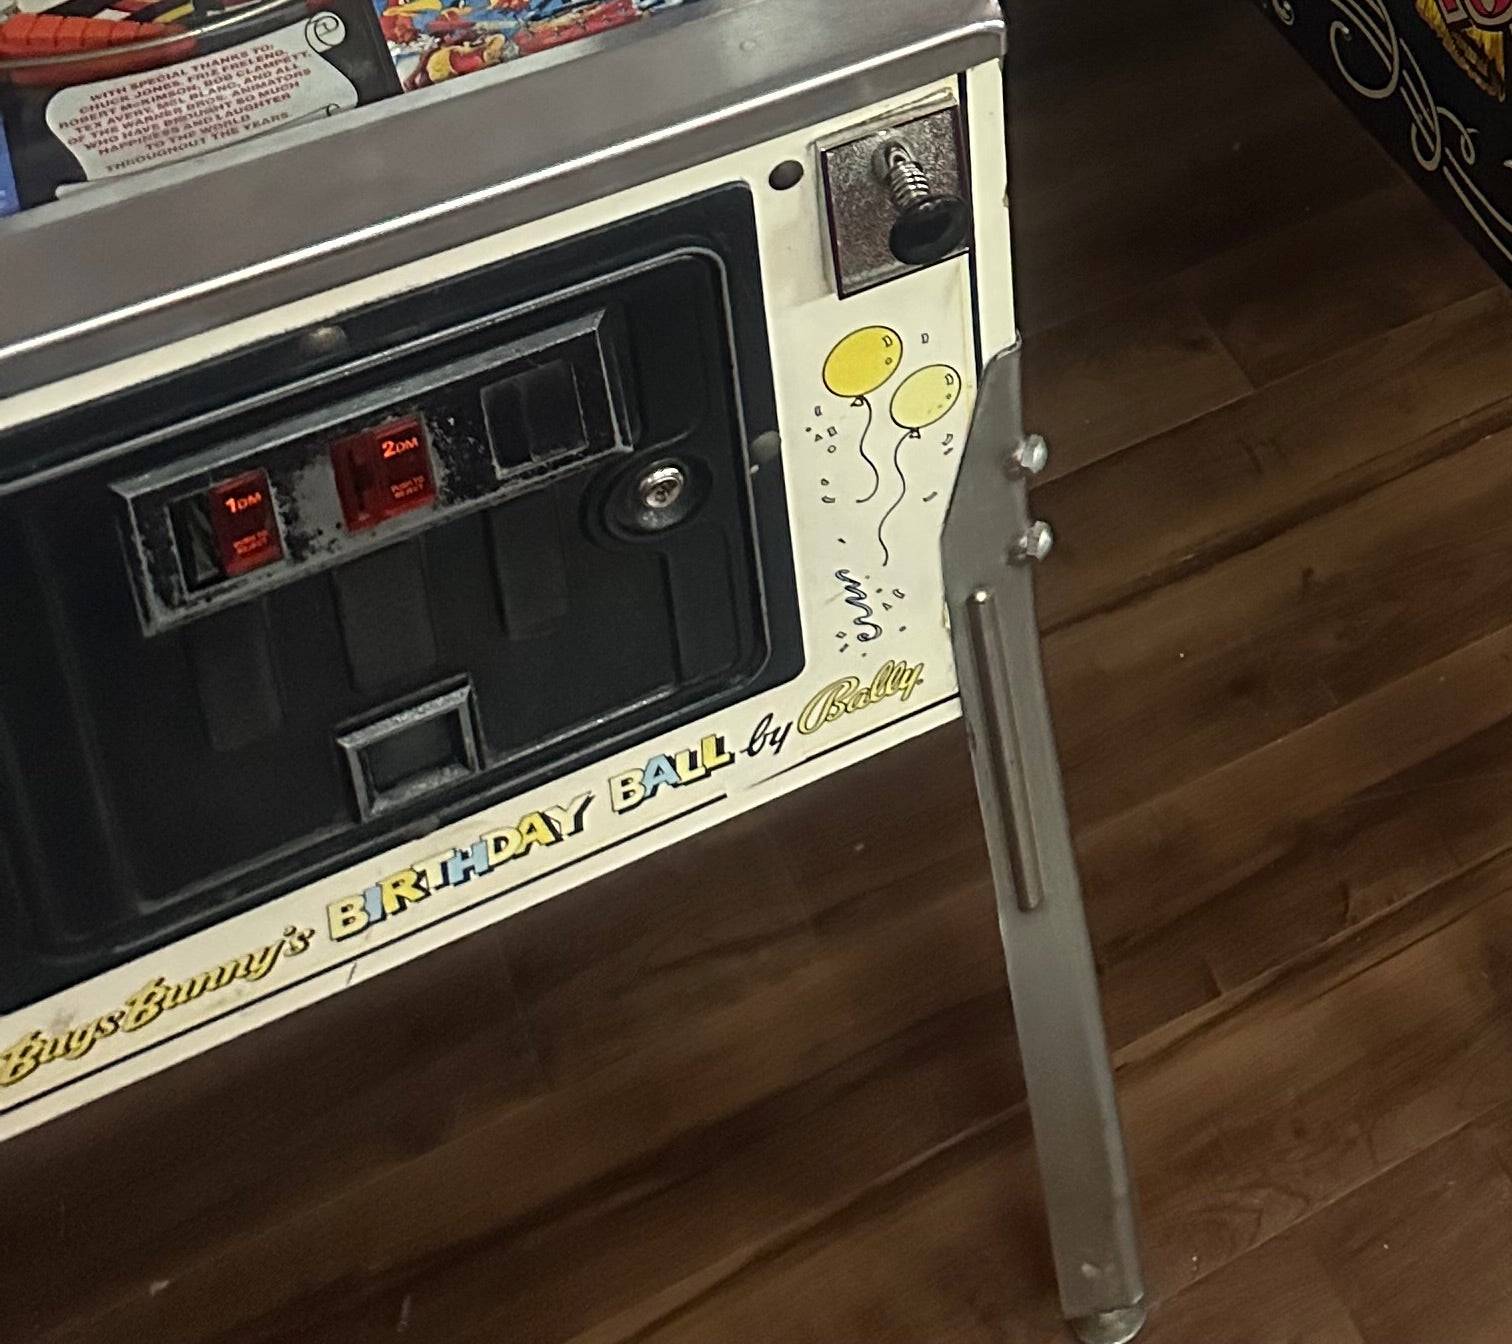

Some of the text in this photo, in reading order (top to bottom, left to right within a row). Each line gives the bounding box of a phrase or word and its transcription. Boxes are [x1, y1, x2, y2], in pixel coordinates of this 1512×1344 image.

[59, 108, 116, 130] ROBERT
[203, 74, 233, 89] BOB
[67, 133, 86, 146] OF
[89, 124, 120, 140] THE
[122, 107, 184, 130] WARNER
[230, 67, 313, 98] ANIMATORS
[75, 121, 102, 134] TEX
[156, 97, 187, 110] MEL
[244, 72, 272, 85] AND
[276, 62, 300, 76] ALL
[79, 95, 130, 114] CHUCK
[187, 68, 220, 82] FRIZ
[90, 86, 127, 102] WITH
[129, 69, 188, 93] SPECIAL
[191, 52, 249, 71] THANKS
[84, 79, 301, 151] WHO HAVE BROUGHT SO MUCH
[98, 91, 293, 156] HAPPINESS AND LAUGHTER
[145, 114, 250, 152] TO THE WORLD
[211, 125, 240, 142] THE
[607, 659, 925, 815] BALL by Bally
[0, 790, 598, 1087] Bugs Bunny's BIRTHDAY
